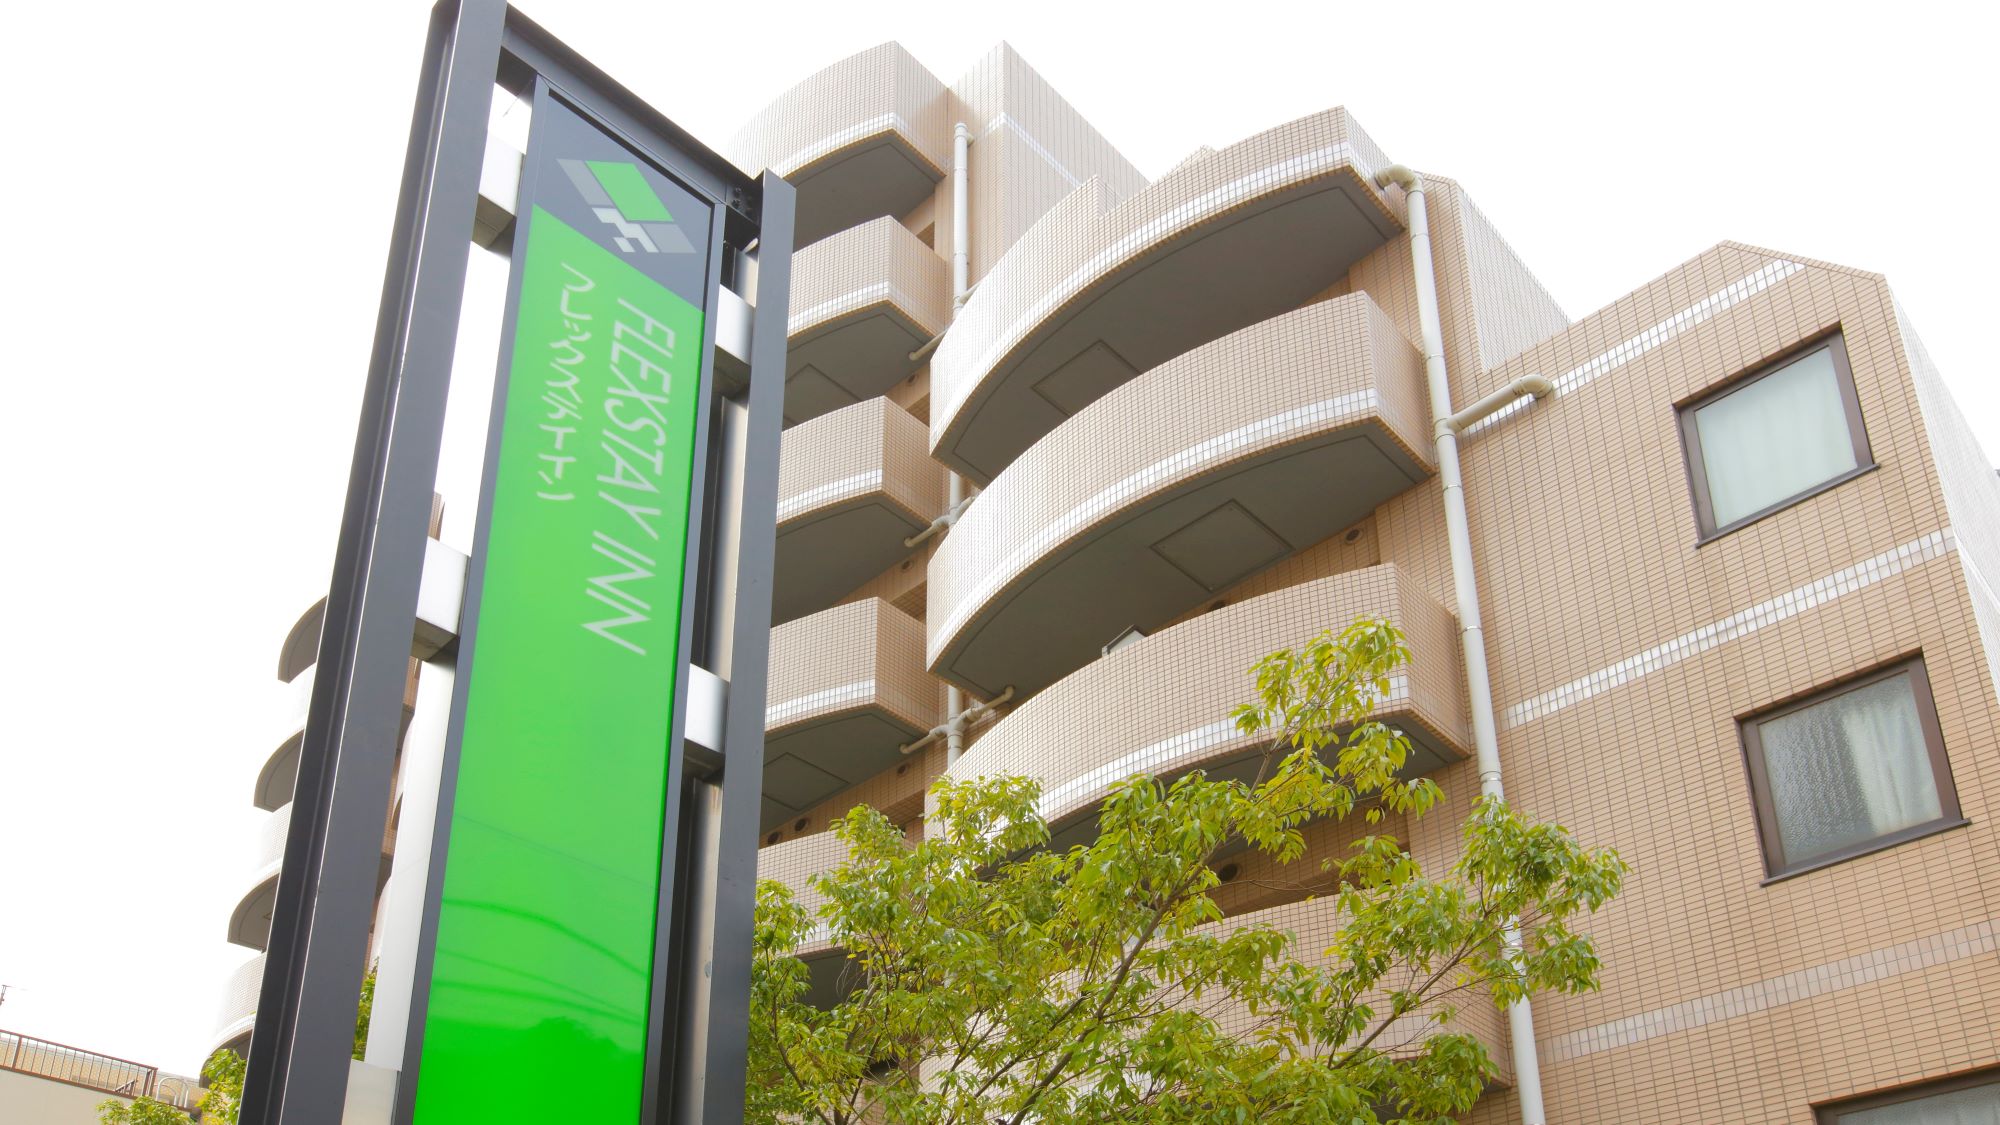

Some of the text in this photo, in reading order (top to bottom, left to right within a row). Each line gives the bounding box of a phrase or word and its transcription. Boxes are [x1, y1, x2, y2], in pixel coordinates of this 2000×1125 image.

[536, 261, 596, 502] フレックステイイン
[581, 297, 677, 655] FLEXSTAY INN
